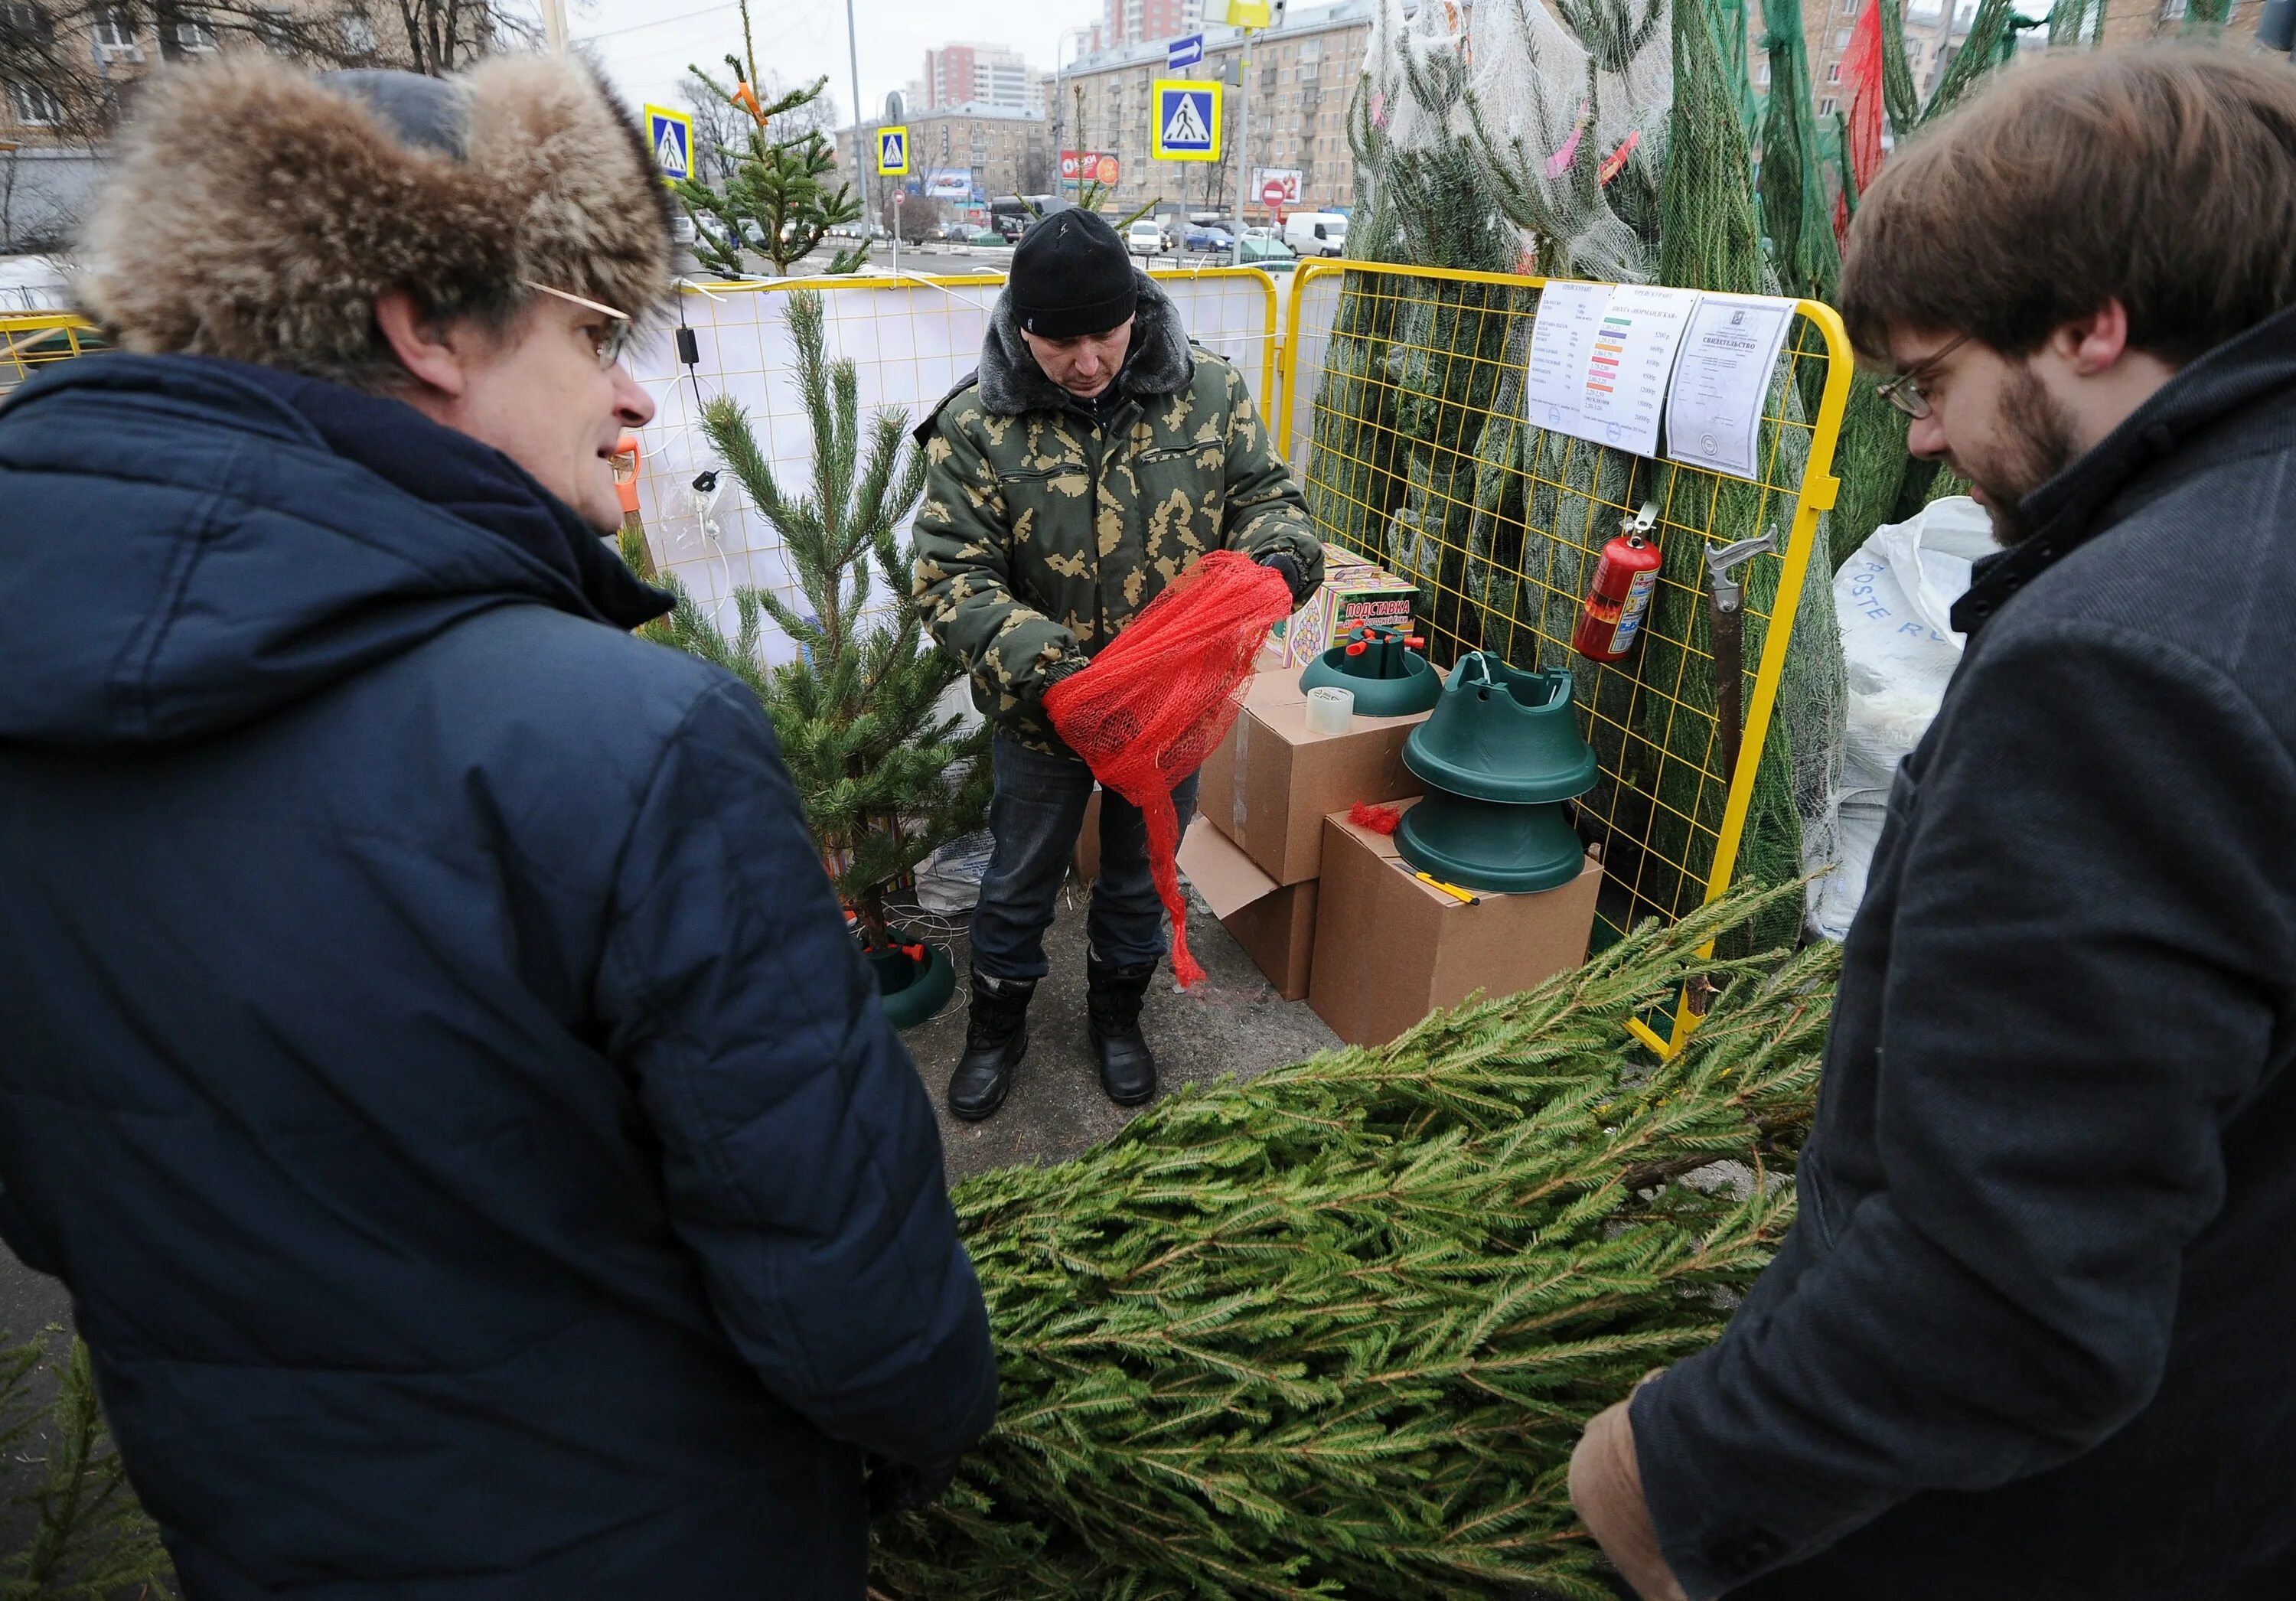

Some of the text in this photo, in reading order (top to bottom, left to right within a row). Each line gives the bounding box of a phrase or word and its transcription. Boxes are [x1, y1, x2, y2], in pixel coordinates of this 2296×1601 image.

[1703, 337, 1756, 350] СВИДЕТЕЛЬСТВО
[1852, 562, 1892, 620] POSTE
[1346, 600, 1410, 618] ПОДСТАВКА
[1393, 615, 1408, 624] ЁЛКИ
